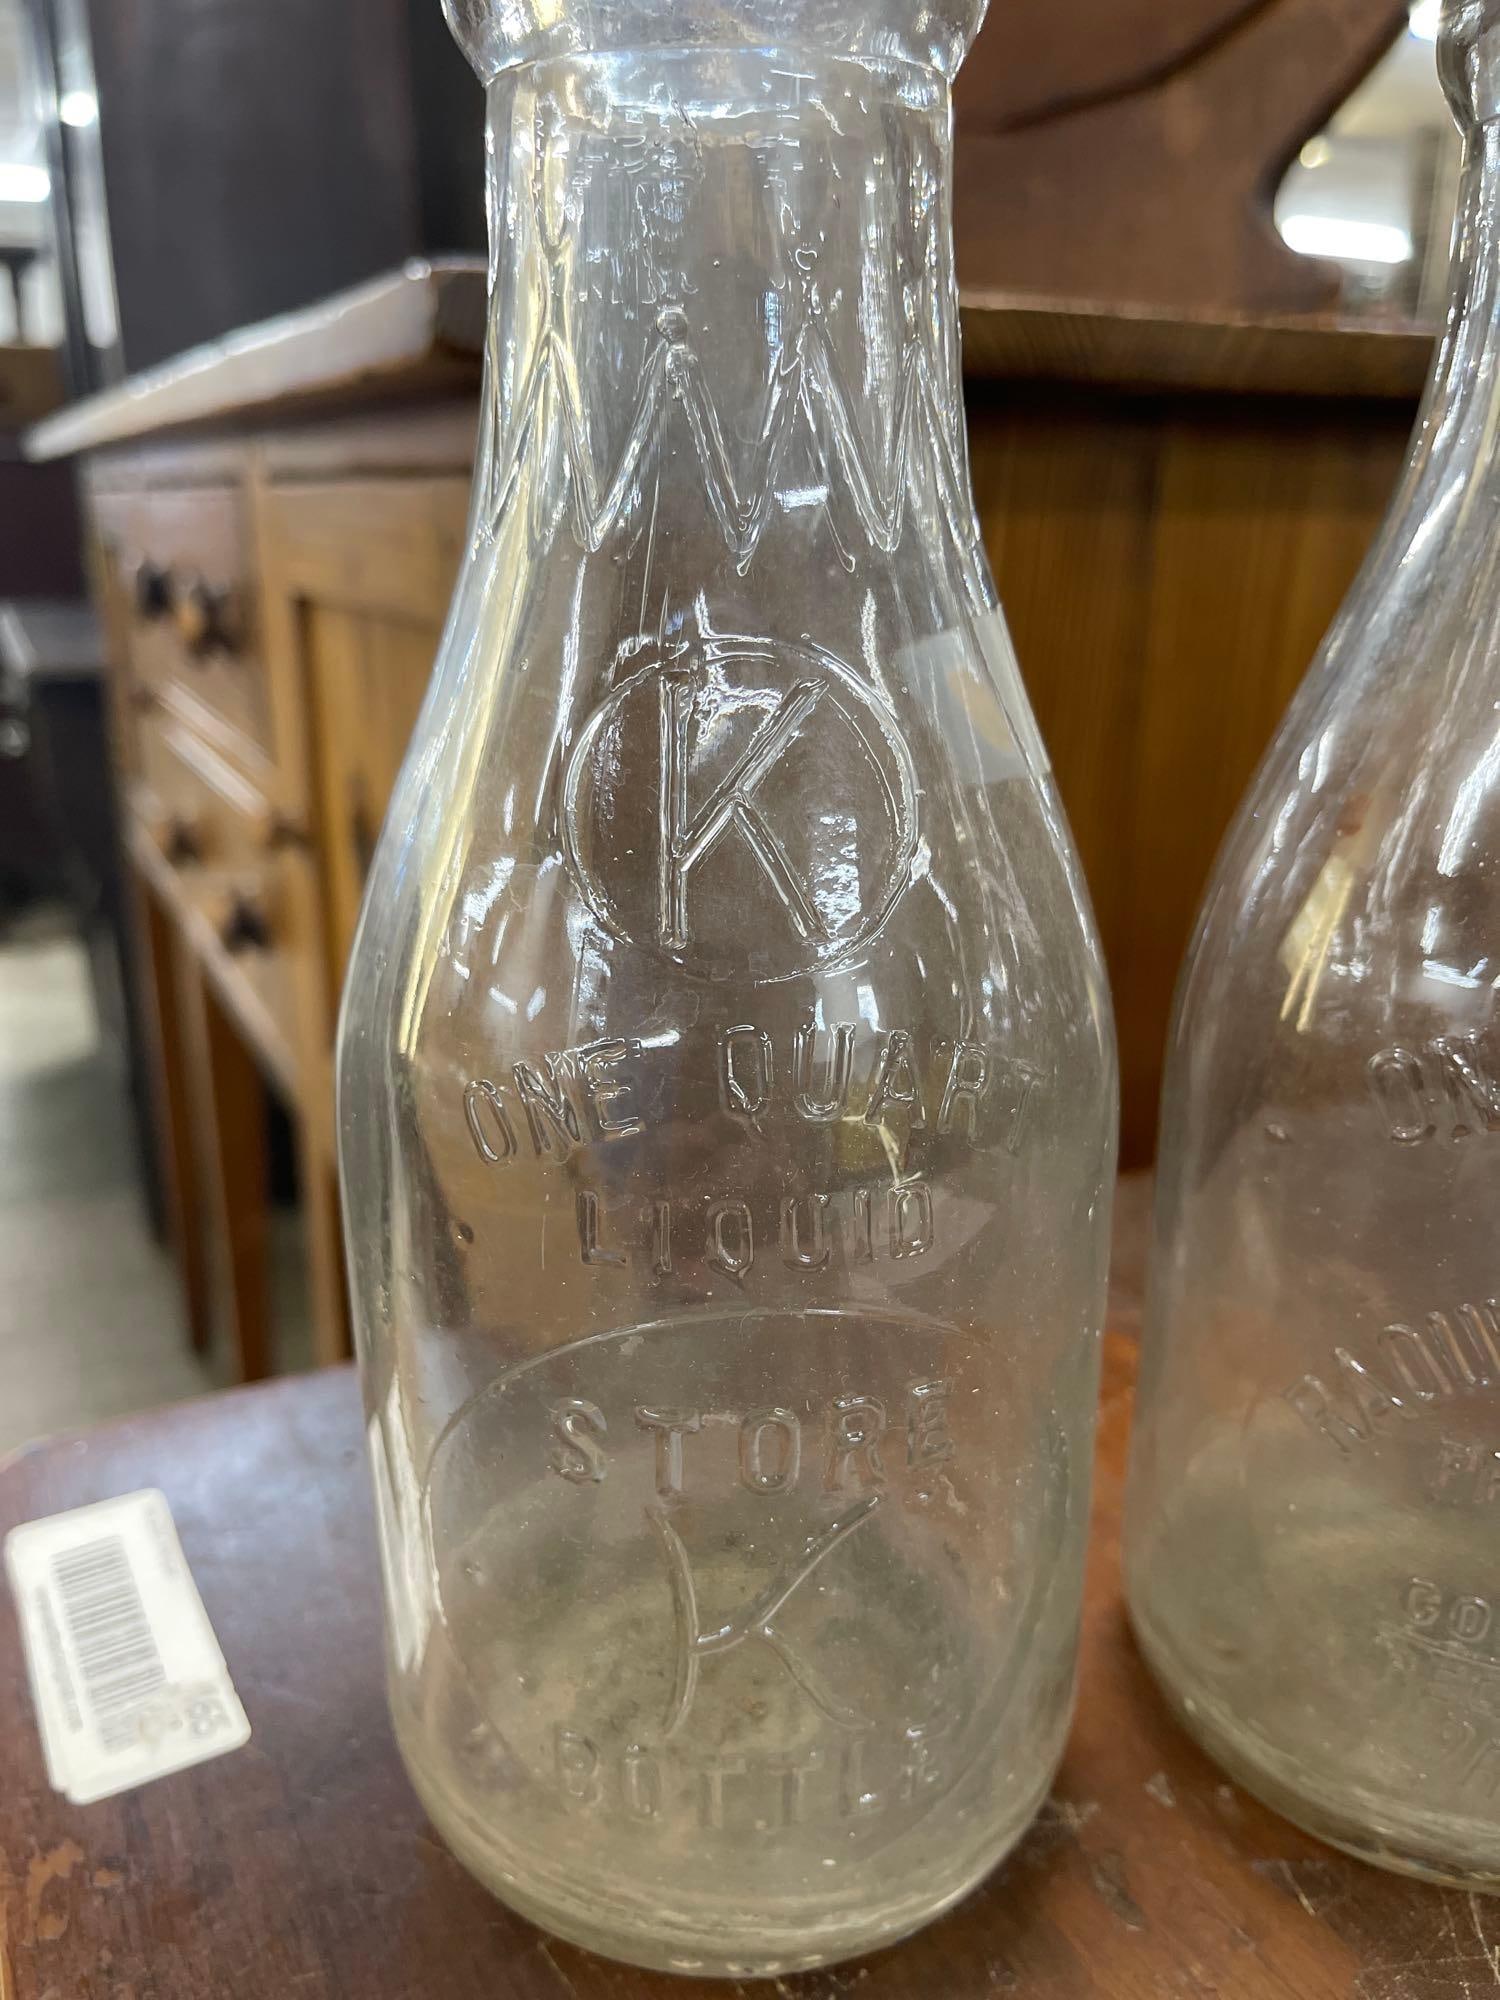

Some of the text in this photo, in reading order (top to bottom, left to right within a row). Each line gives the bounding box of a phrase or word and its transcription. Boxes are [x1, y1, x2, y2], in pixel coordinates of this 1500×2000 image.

[657, 667, 838, 950] K
[463, 1021, 1046, 1167] ONE QUART
[576, 1181, 934, 1289] LIQUID
[551, 1376, 958, 1497] STORE
